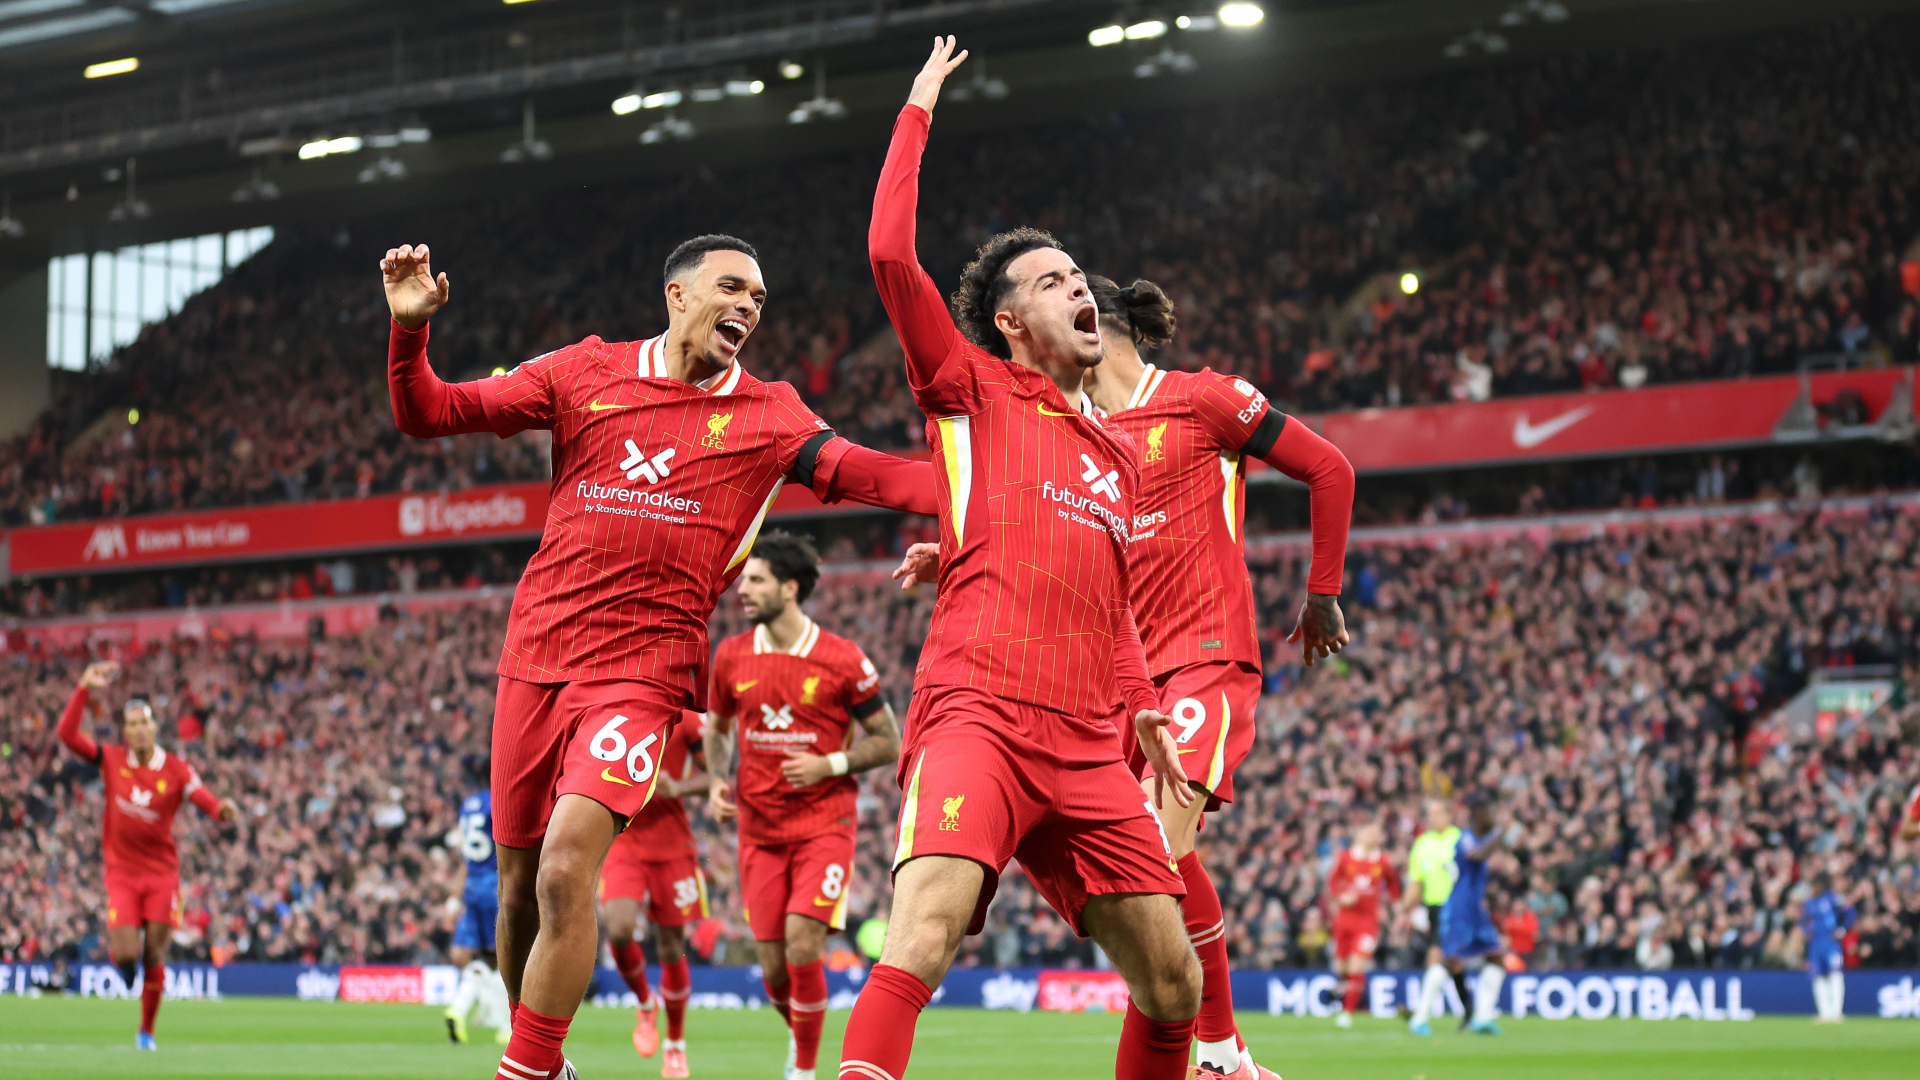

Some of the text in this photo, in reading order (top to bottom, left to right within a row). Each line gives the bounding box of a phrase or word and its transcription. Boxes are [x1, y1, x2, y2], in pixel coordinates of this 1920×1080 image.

[1237, 392, 1266, 424] Expe
[577, 480, 702, 514] futuremakers
[584, 503, 685, 524] by Standard Chartered
[1058, 508, 1070, 520] by
[1172, 697, 1207, 744] 9
[590, 714, 658, 783] 66
[821, 863, 845, 900] 8
[1267, 973, 1398, 1018] MOE
[1511, 974, 1756, 1021] FOOTBALL
[1877, 975, 1920, 1018] sk
